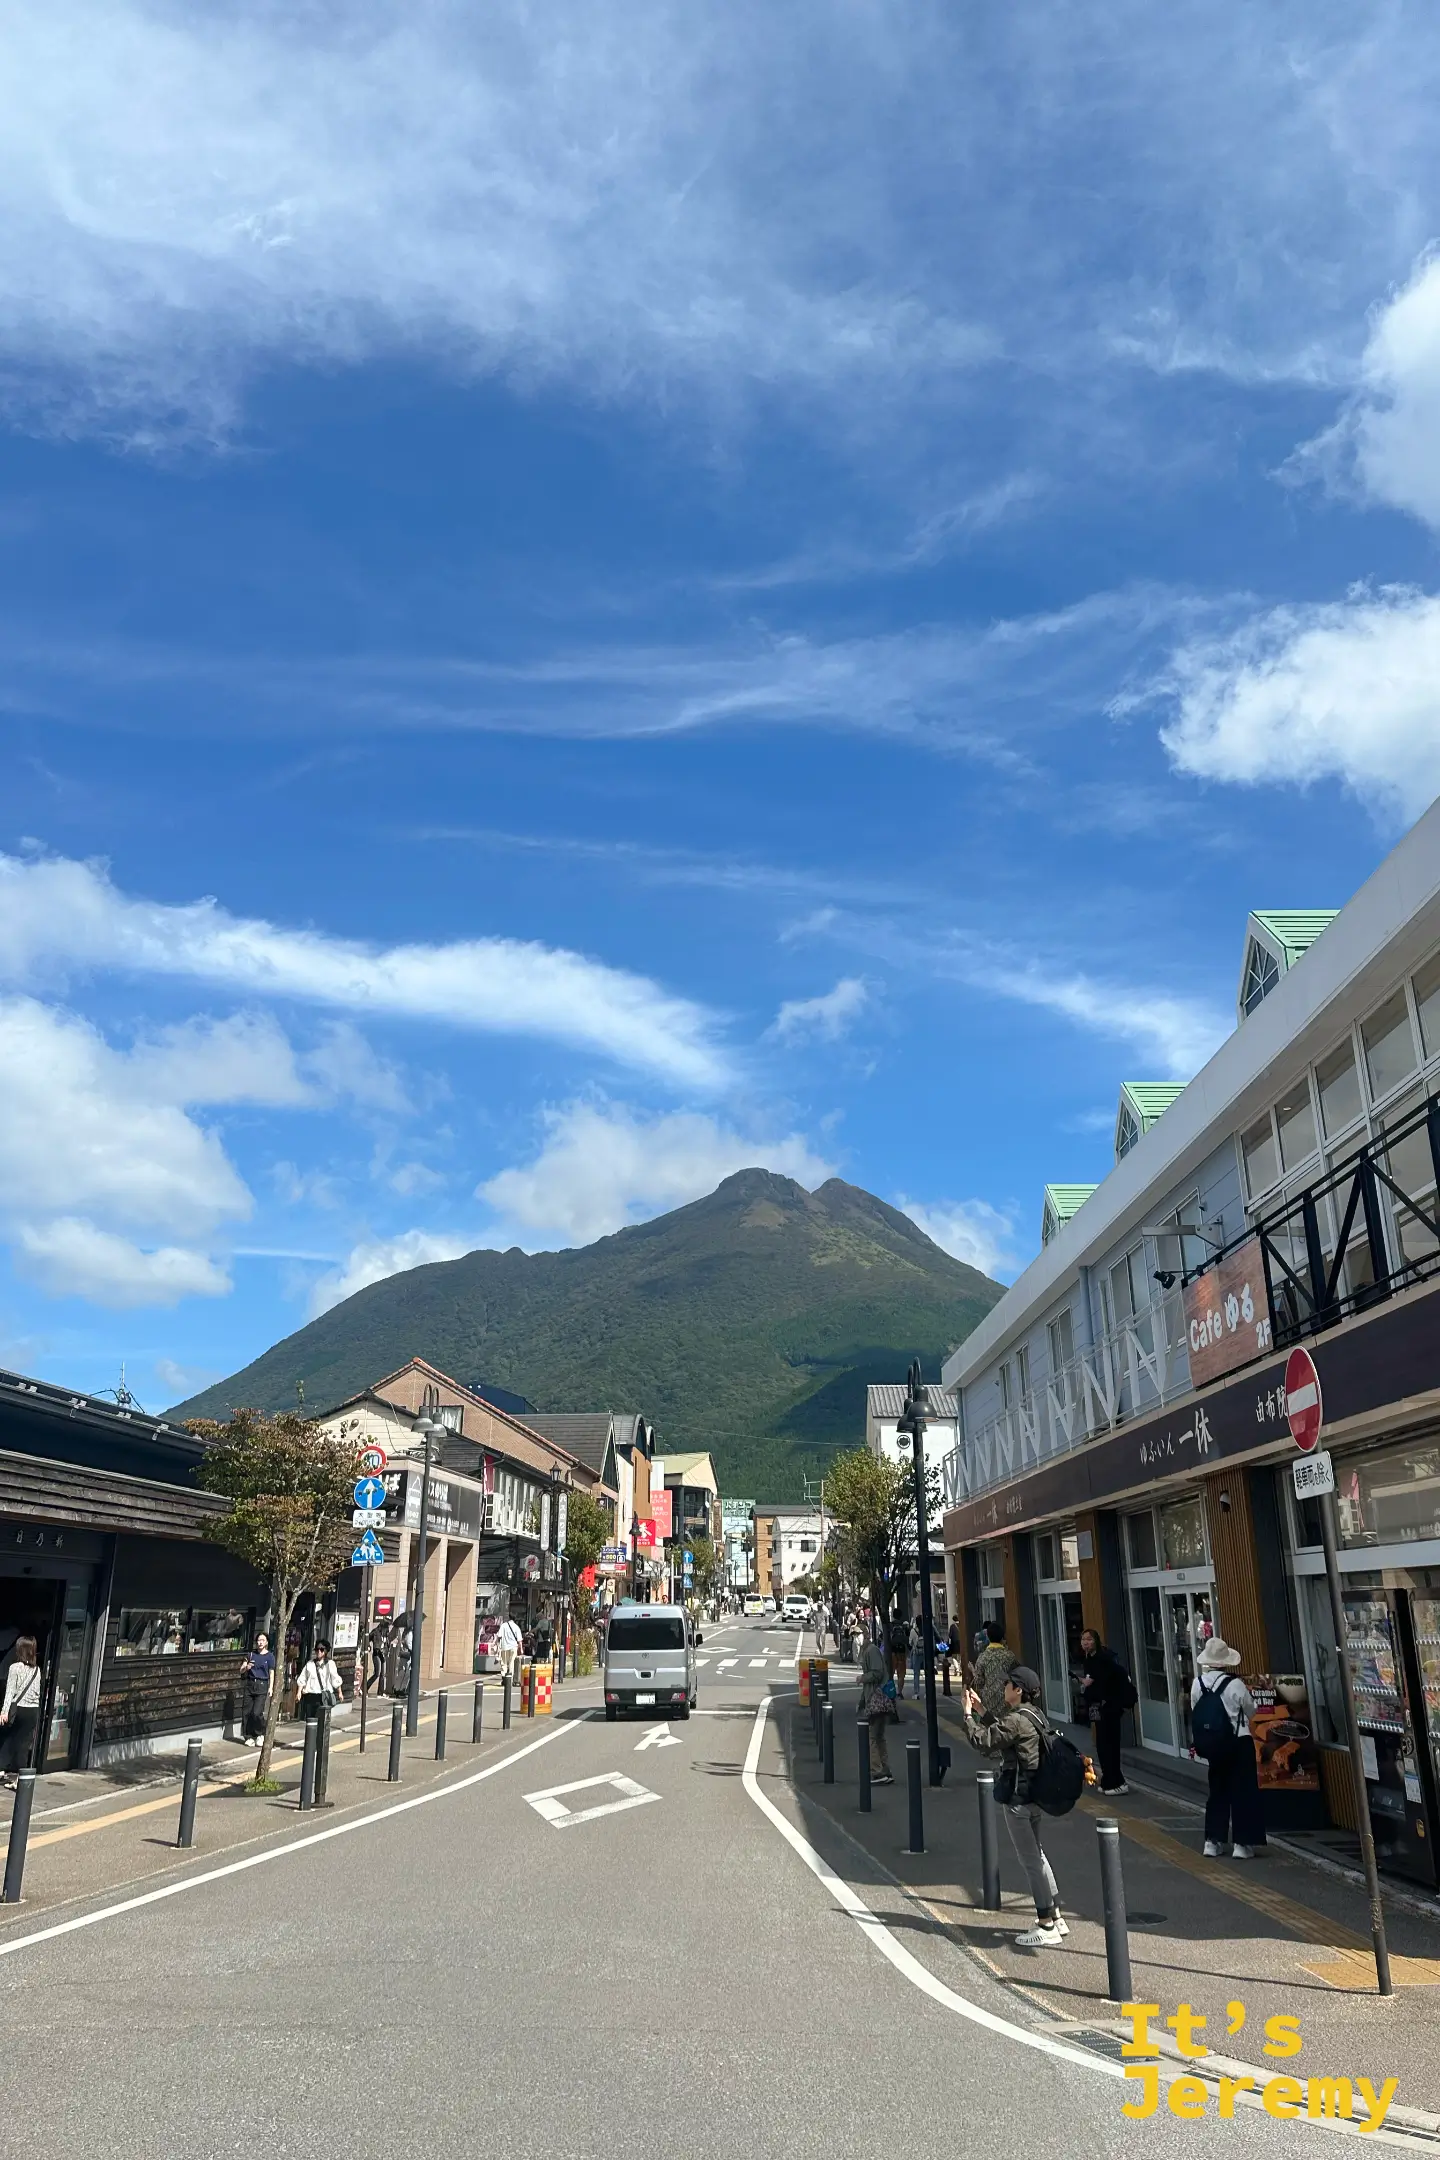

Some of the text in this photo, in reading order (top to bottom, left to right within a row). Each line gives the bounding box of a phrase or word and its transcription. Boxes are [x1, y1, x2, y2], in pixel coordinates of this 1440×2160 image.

[1225, 1283, 1253, 1332] ゆる
[1191, 1310, 1222, 1351] Cafe
[1256, 1318, 1270, 1348] 2F
[1140, 1408, 1213, 1465] ゆふいん 一休
[1295, 1462, 1330, 1489] 軽車両を除く
[559, 1496, 567, 1537] バスのりば
